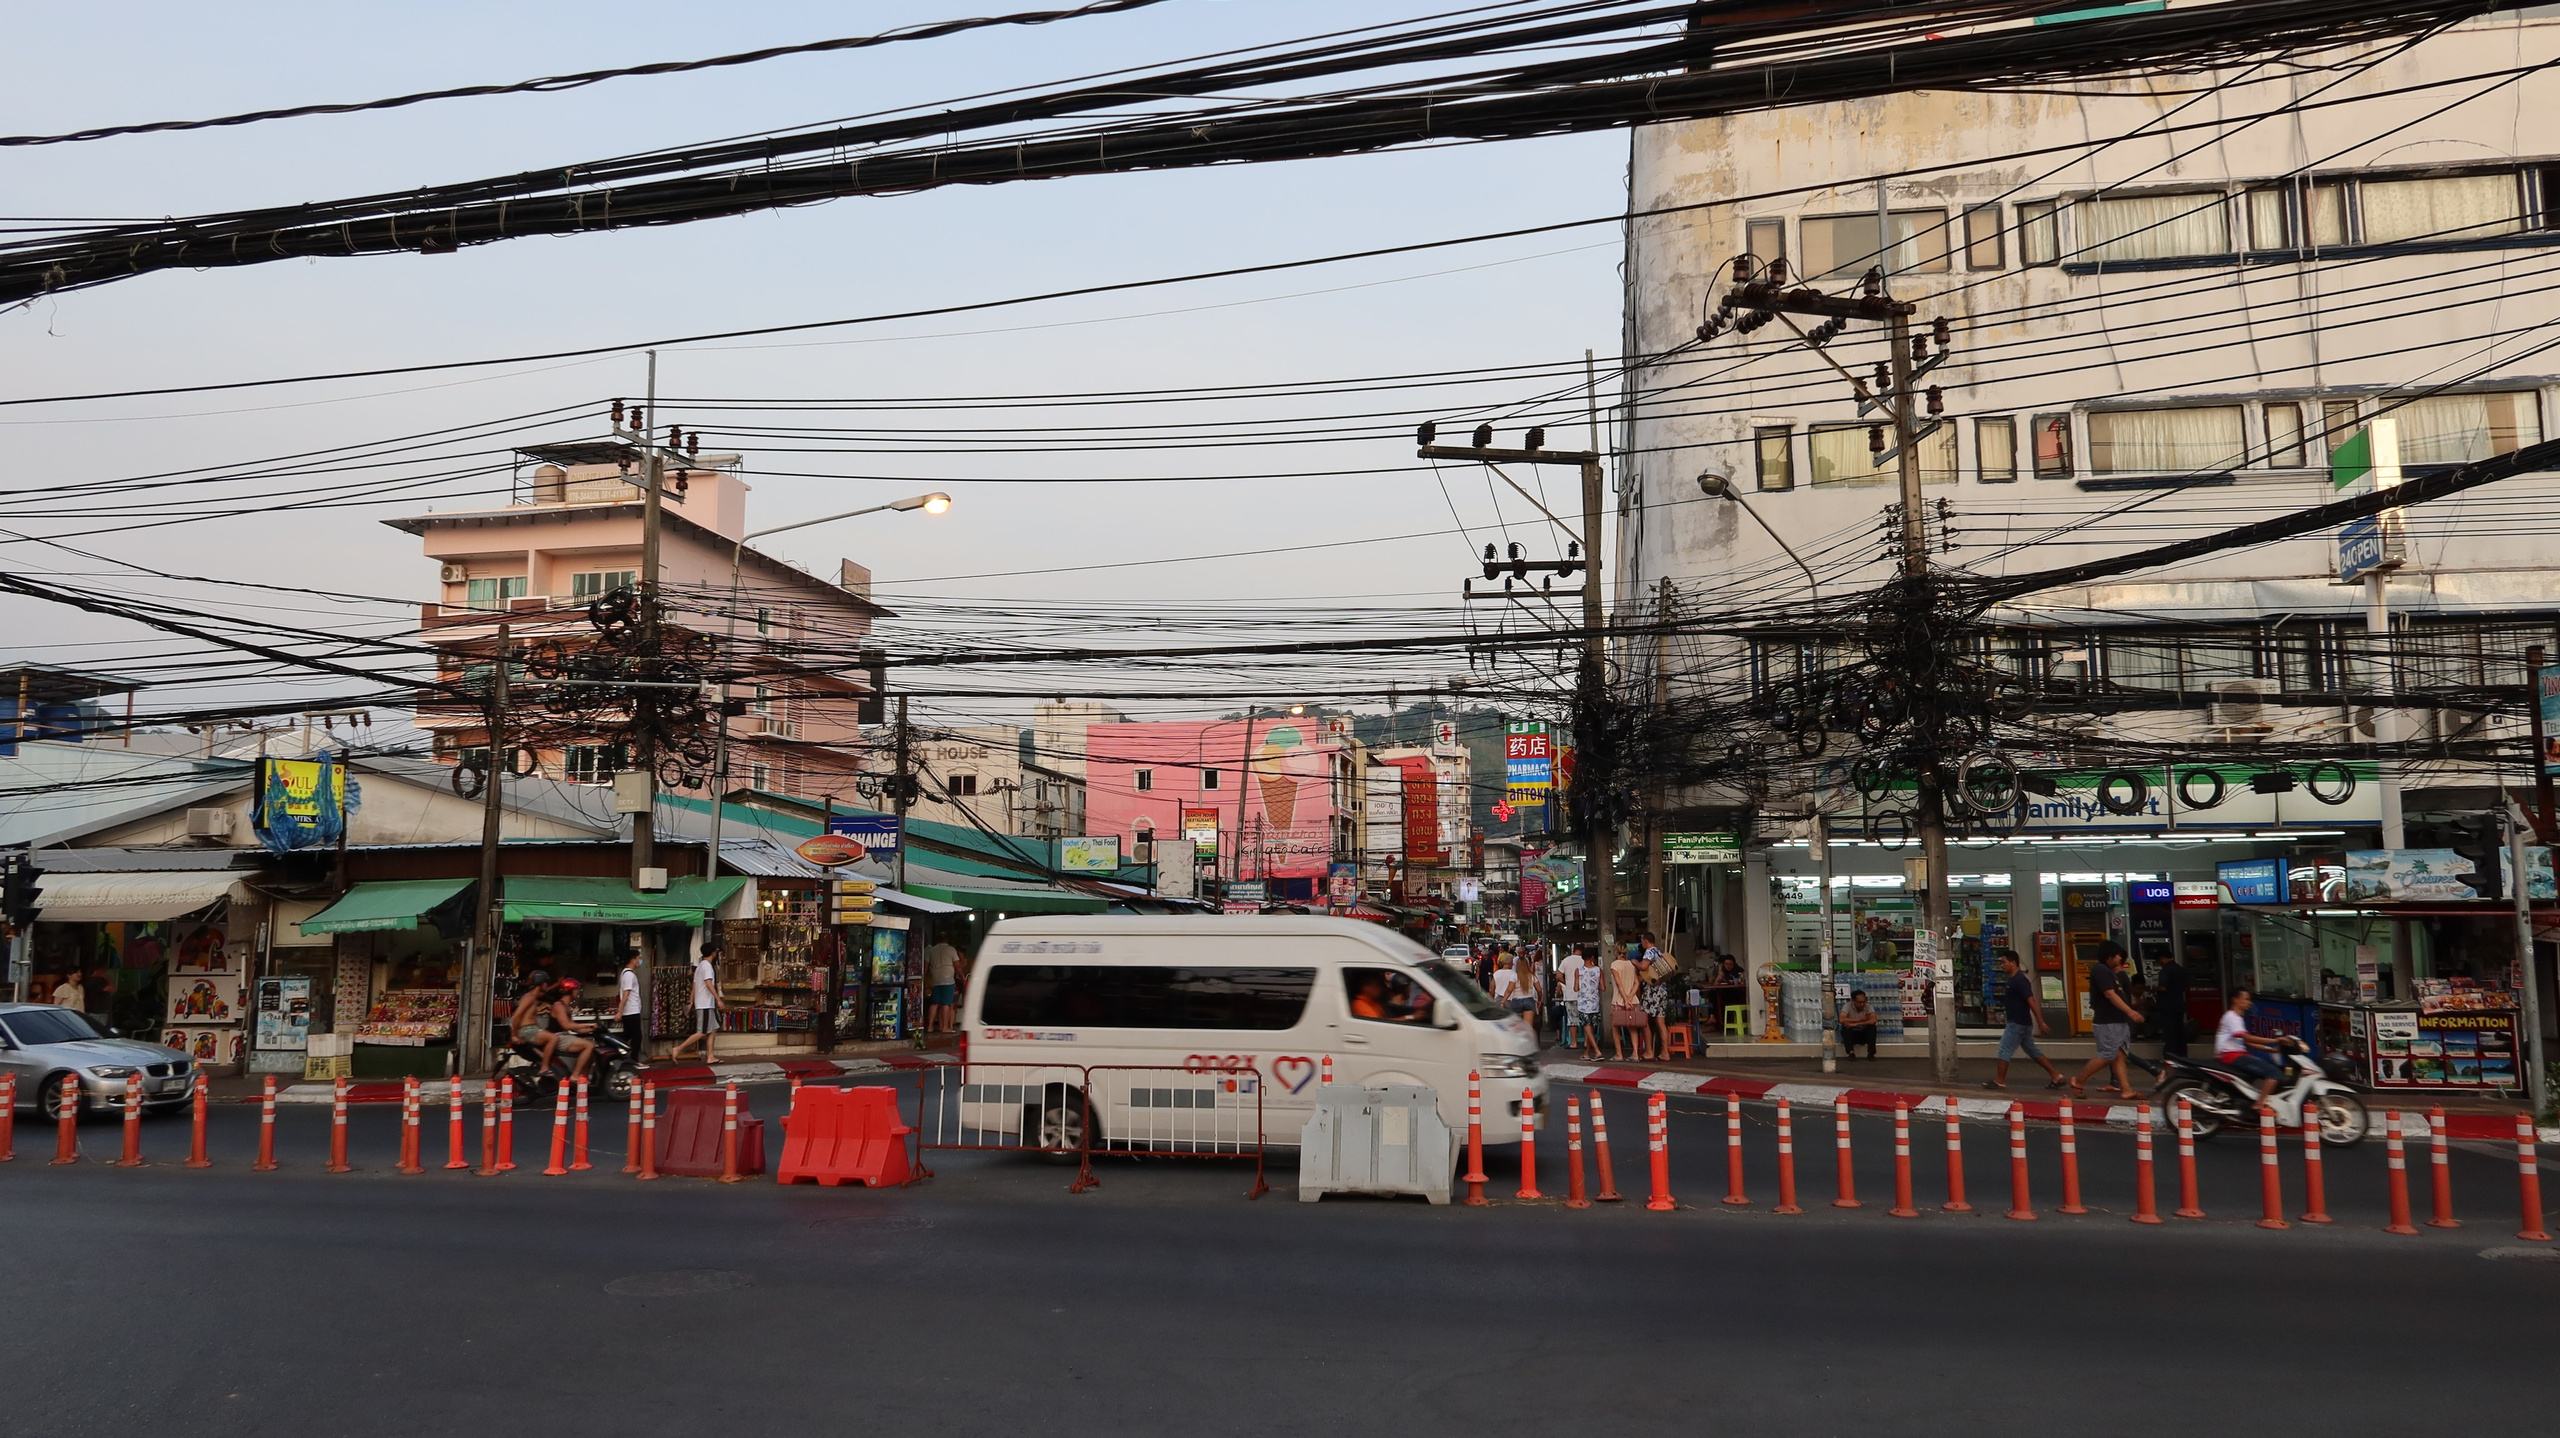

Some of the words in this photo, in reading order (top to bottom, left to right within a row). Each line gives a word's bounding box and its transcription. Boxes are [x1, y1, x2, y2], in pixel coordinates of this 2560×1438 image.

[1509, 737, 1547, 757] 药店
[937, 747, 989, 760] HOUSE
[1507, 763, 1550, 777] PHARMACY
[1677, 836, 1720, 844] FamilyMart
[1416, 840, 1429, 853] 5
[1777, 892, 1803, 900] 0449
[2147, 889, 2170, 898] UOB
[2140, 920, 2163, 928] ATM
[2420, 1017, 2509, 1028] INFORMATION
[1183, 1054, 1258, 1075] anex
